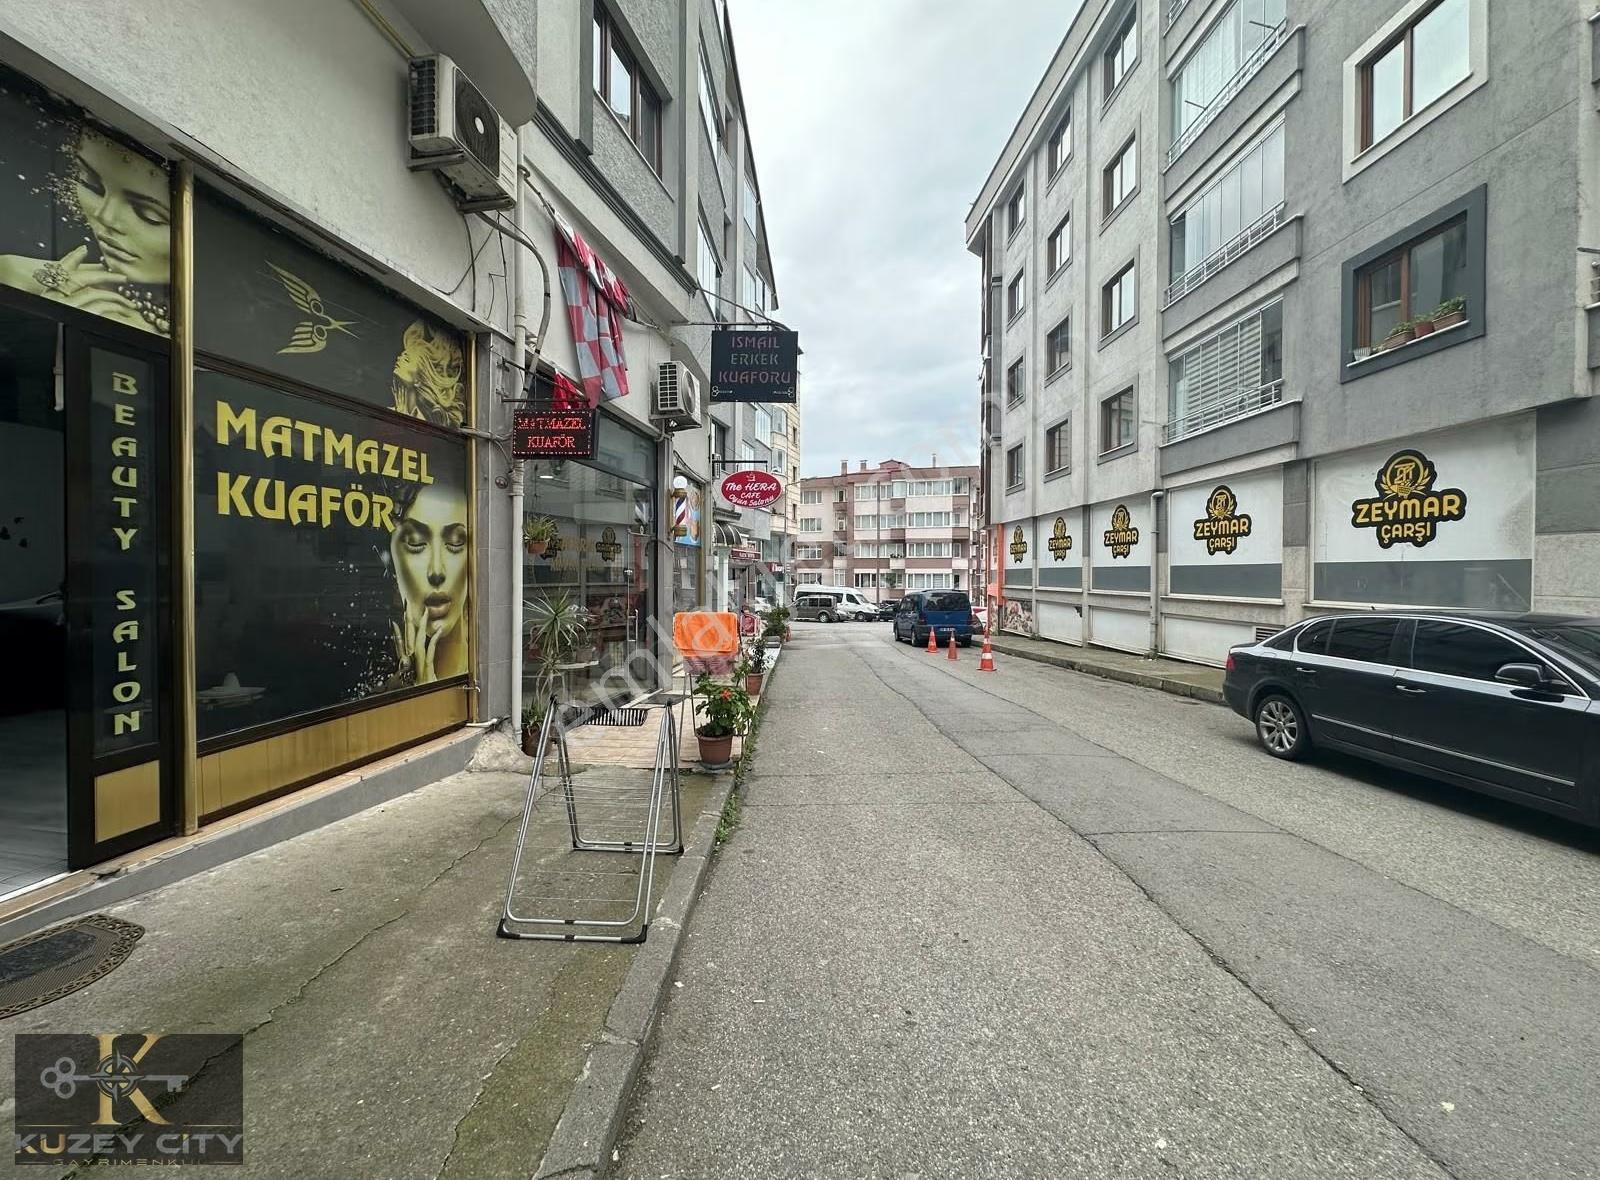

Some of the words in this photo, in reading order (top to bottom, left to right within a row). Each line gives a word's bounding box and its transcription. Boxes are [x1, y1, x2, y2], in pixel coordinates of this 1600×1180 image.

[731, 336, 780, 349] ISMAIL
[730, 353, 779, 366] ERKEK
[215, 400, 435, 485] MATMAZEL
[527, 434, 575, 448] KUAFÖR
[111, 371, 138, 551] BEAUTY
[726, 482, 743, 491] The
[744, 482, 777, 491] HERA
[216, 471, 397, 533] KUAFÖR
[1355, 494, 1461, 524] ZEYMAR
[1104, 530, 1138, 544] ZEYMAR
[1195, 517, 1248, 537] ZEYMAR
[1381, 522, 1431, 544] ÇARŞI
[1209, 537, 1235, 551] ÇARŞI
[112, 589, 141, 735] SALON
